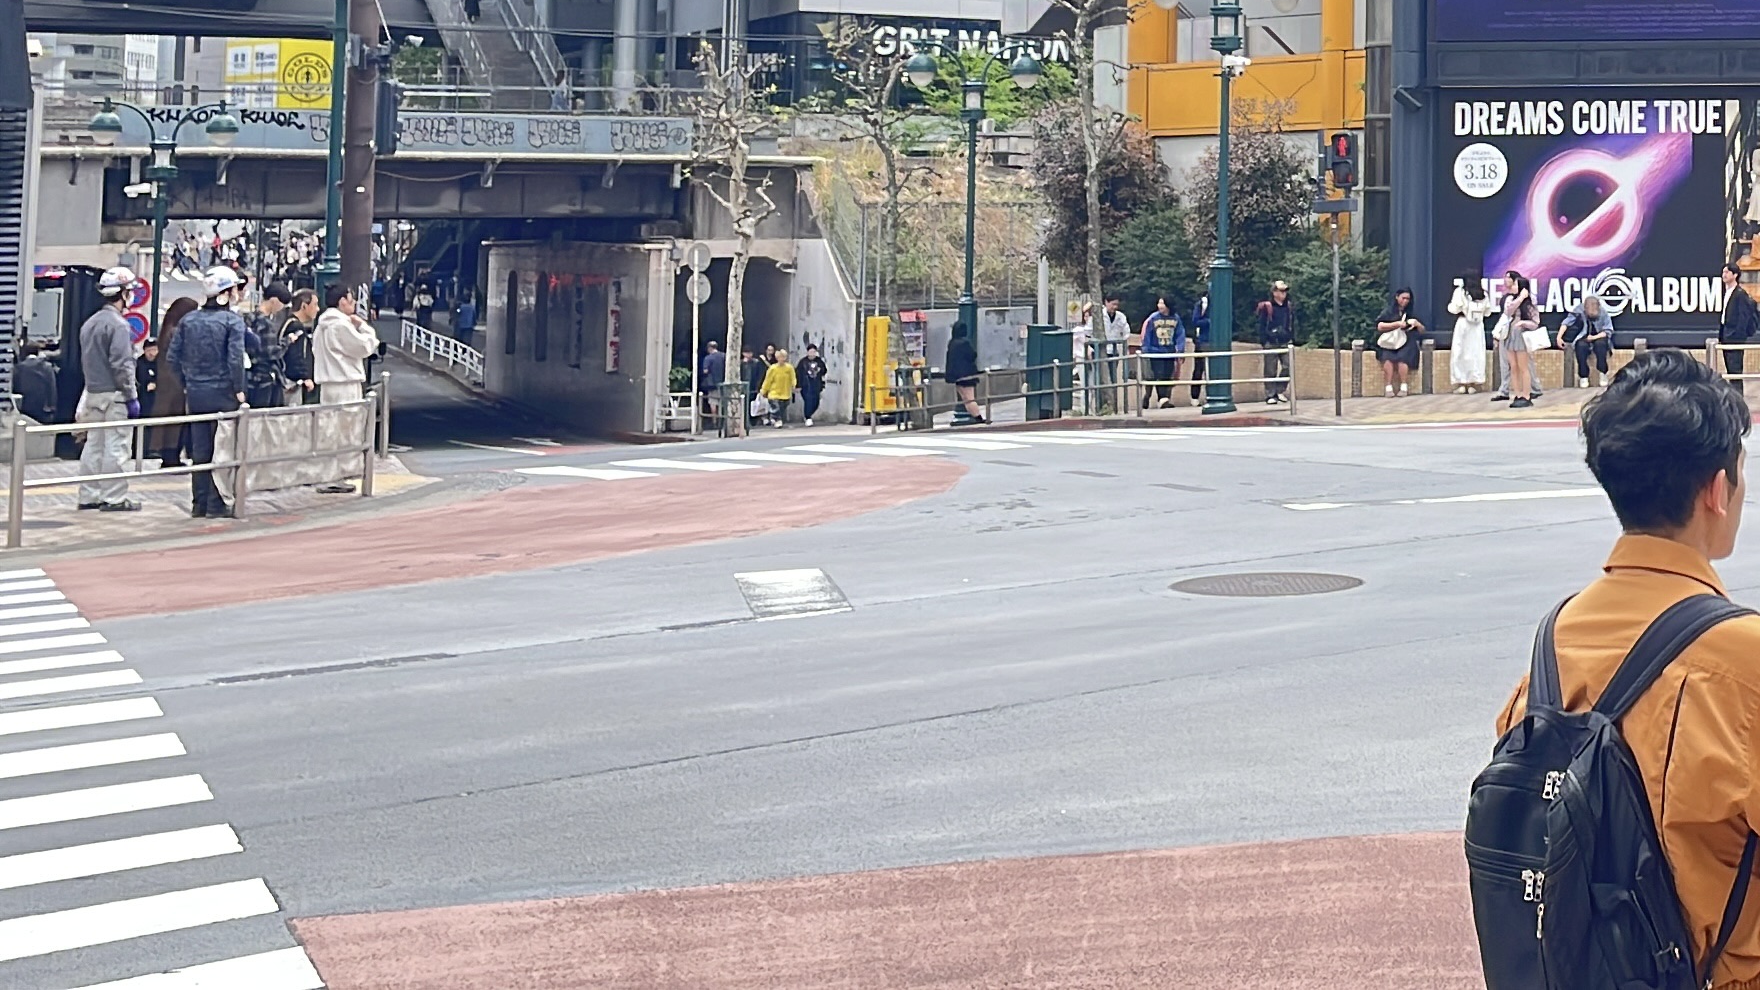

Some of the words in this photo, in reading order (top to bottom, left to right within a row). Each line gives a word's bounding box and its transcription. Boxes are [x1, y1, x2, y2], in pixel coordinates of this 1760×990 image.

[1454, 100, 1564, 136] DREAMS
[1571, 100, 1647, 135] COME
[1655, 99, 1723, 135] TRUE
[1464, 163, 1498, 180] 3.18
[1632, 276, 1725, 313] ALBUM
